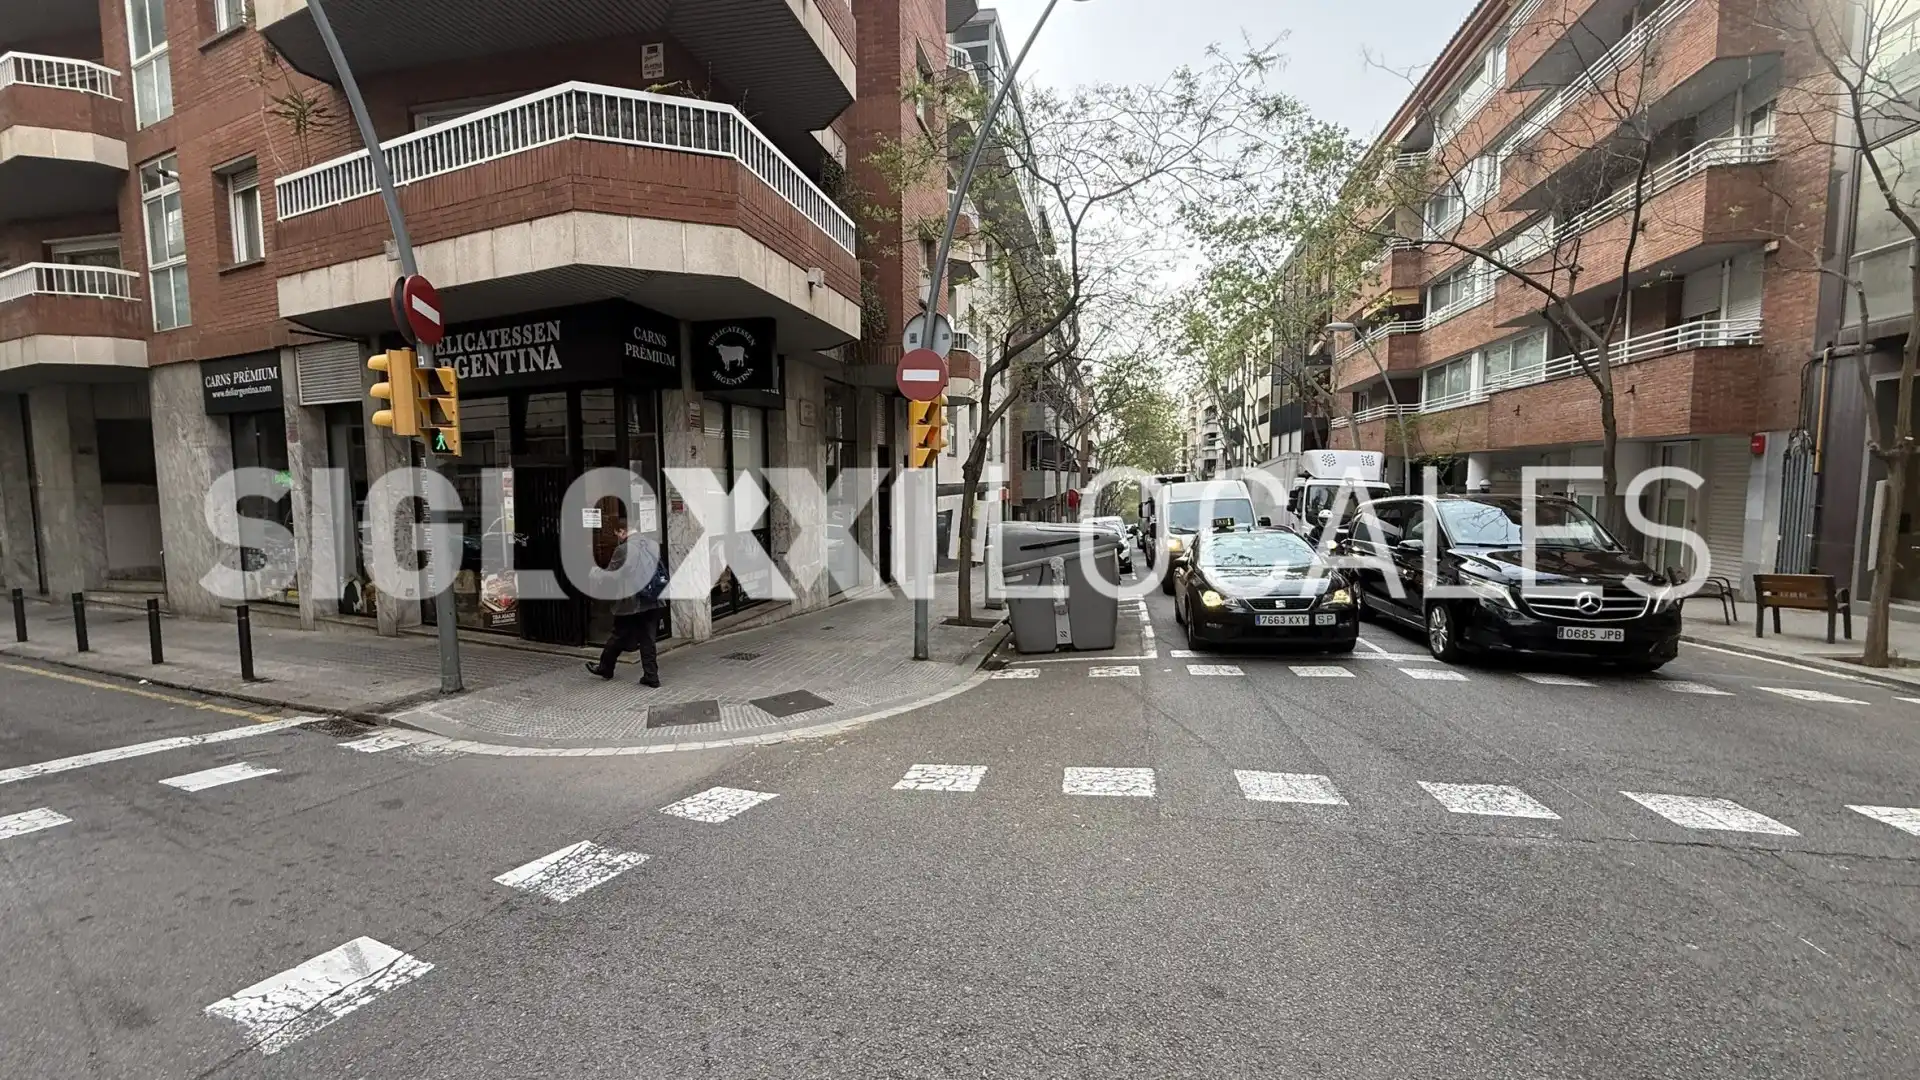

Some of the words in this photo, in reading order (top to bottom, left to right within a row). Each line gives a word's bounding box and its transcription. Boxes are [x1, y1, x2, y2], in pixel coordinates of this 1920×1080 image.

[432, 320, 560, 356] ELICATESSEN
[633, 326, 667, 347] CARNS
[708, 326, 755, 346] DELICATESSEN
[439, 344, 562, 379] GENTINA
[205, 373, 231, 388] CARNS
[712, 368, 753, 385] ARGENTINA
[1261, 615, 1286, 625] 7663
[1288, 615, 1308, 625] KXY
[1566, 628, 1596, 640] 0685
[1600, 630, 1622, 640] JPB
